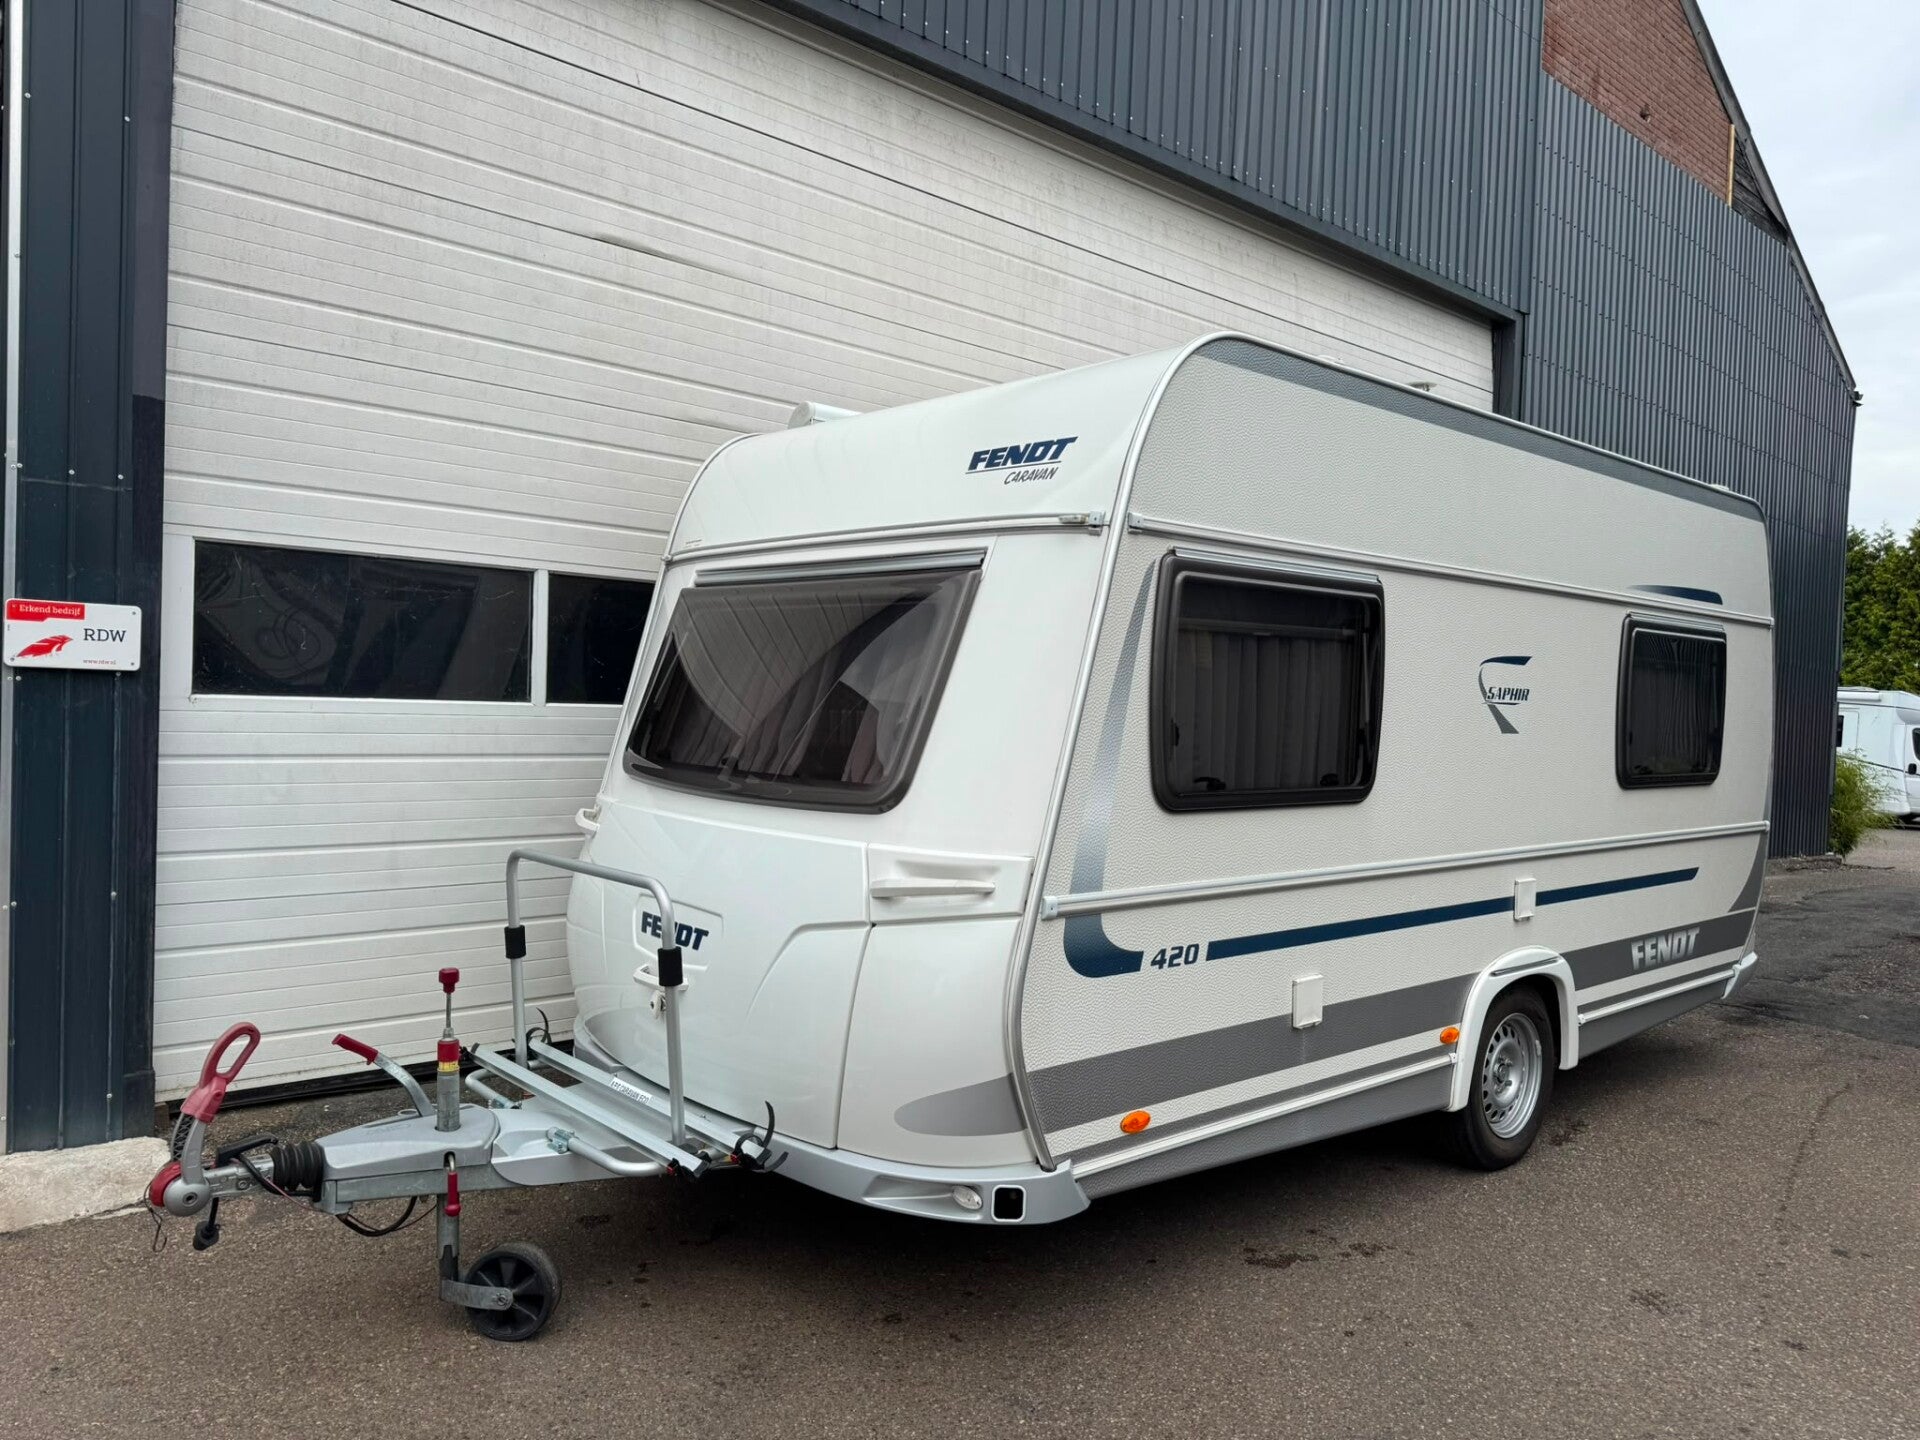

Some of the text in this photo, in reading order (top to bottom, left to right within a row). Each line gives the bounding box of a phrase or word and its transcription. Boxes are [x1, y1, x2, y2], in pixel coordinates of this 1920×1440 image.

[967, 436, 1079, 471] FENDT
[1003, 466, 1059, 485] CARAVAN
[19, 603, 81, 617] Erkend bedrijf
[83, 628, 127, 643] RDW
[1487, 686, 1530, 701] SAPHIR
[641, 910, 709, 951] FEDT
[1150, 943, 1200, 970] 420
[1631, 926, 1700, 971] FENDT
